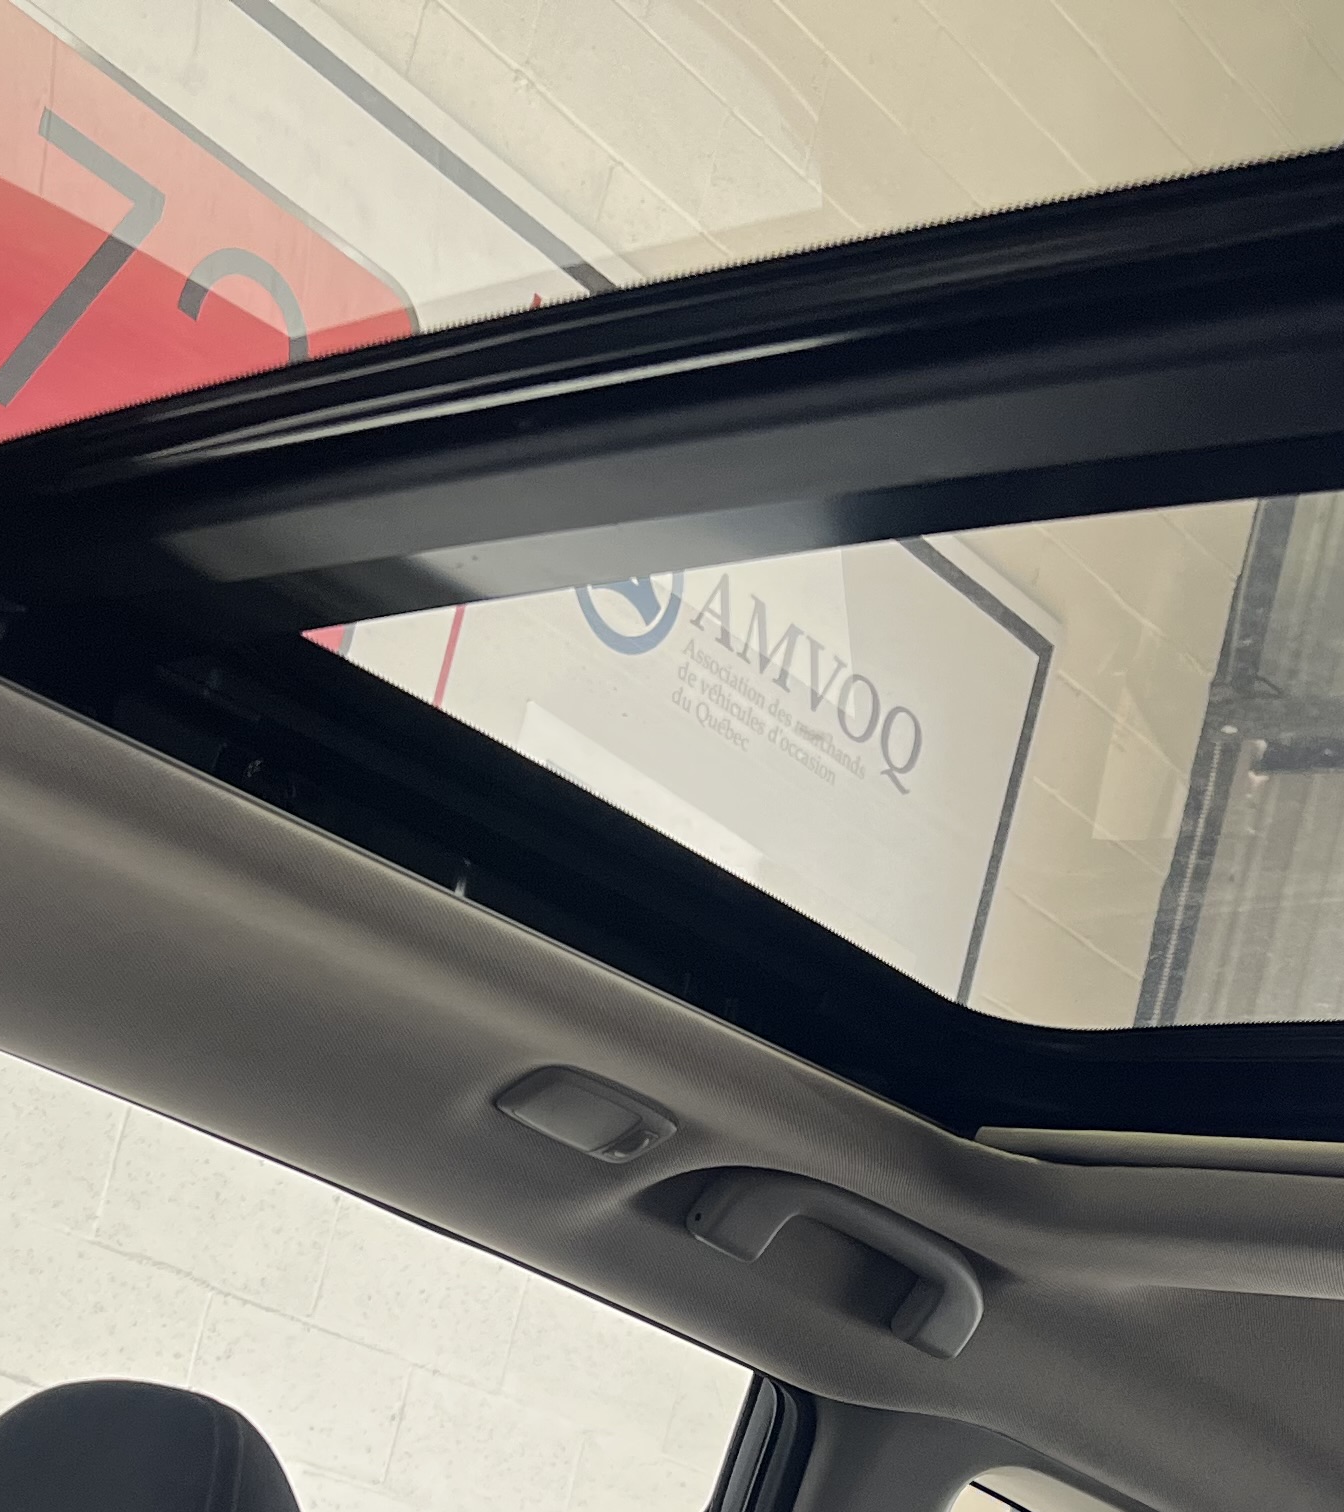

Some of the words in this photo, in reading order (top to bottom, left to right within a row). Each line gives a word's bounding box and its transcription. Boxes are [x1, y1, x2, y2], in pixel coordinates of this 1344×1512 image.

[671, 687, 693, 714] du
[695, 701, 751, 753] Québec
[677, 662, 698, 686] de
[700, 679, 766, 735] véhicules
[768, 728, 837, 786] d'occasion
[682, 638, 765, 706] Association
[768, 699, 792, 727] des
[690, 572, 922, 795] AMVOQ
